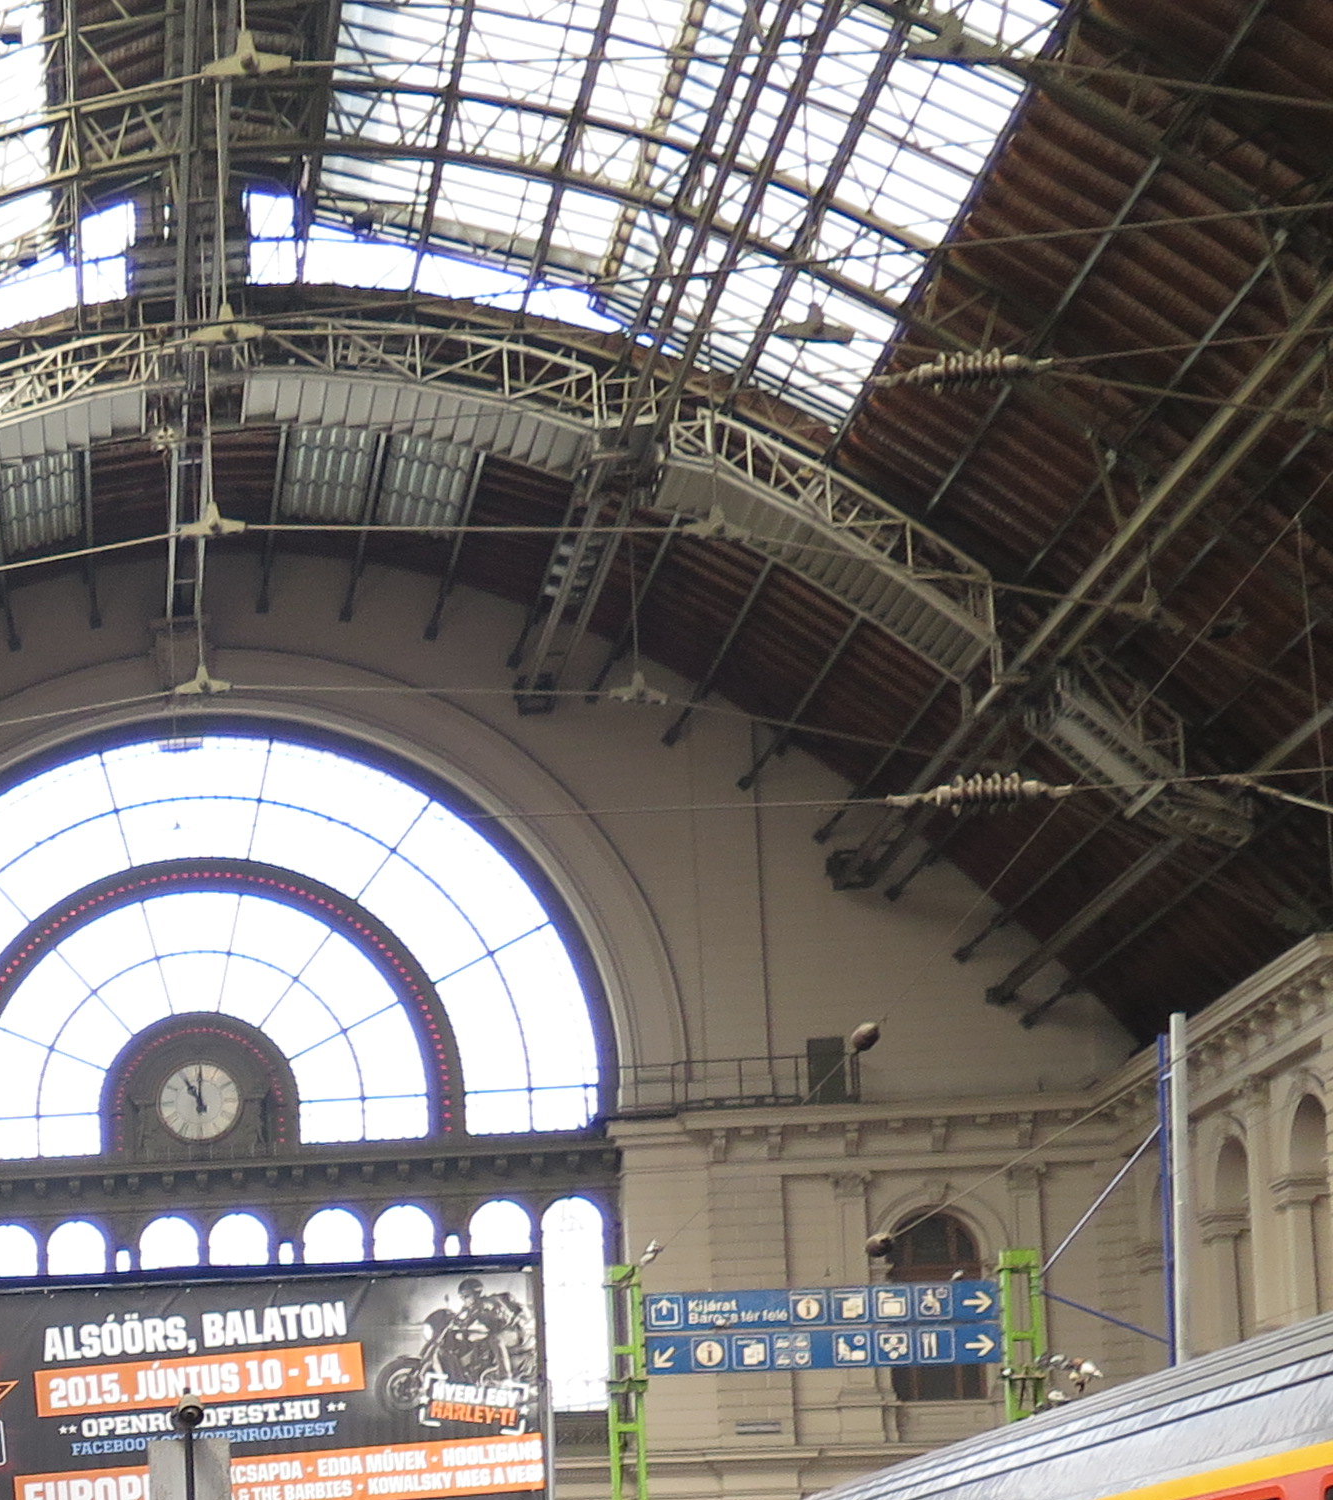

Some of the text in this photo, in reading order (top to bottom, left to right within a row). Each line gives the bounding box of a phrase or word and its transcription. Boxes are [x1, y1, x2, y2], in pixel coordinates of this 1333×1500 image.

[688, 1299, 738, 1313] Kijárat
[44, 1301, 348, 1362] ALSÓÖRS, BALATON
[49, 1372, 128, 1408] 2015.
[134, 1361, 241, 1401] JÚNIUS
[246, 1359, 283, 1392] 10
[305, 1353, 350, 1387] 14.
[432, 1382, 484, 1404] NYERJ
[81, 1399, 320, 1438] OPENRDFEST.HU
[431, 1400, 517, 1426] HARLEY-T!
[317, 1456, 362, 1477] EDDA
[442, 1440, 542, 1467] HOOLIGANS
[284, 1480, 353, 1500] BARBIES
[367, 1471, 452, 1496] KOWALSKY
[455, 1468, 491, 1488] MEG
